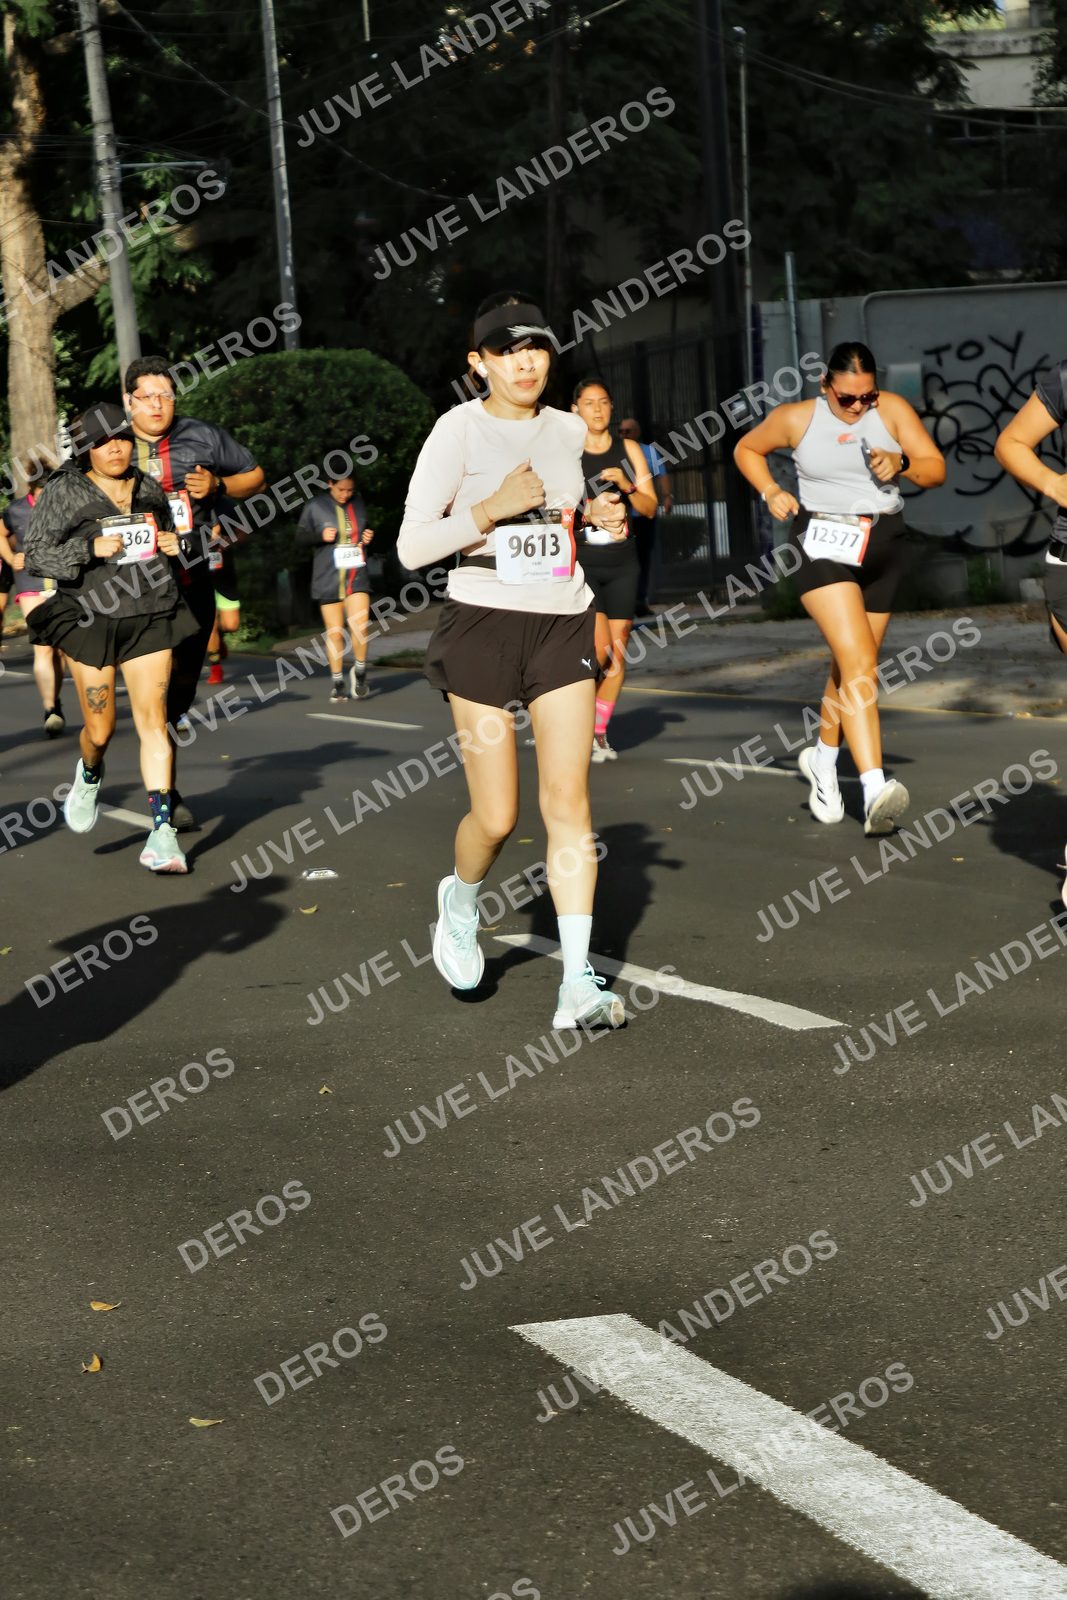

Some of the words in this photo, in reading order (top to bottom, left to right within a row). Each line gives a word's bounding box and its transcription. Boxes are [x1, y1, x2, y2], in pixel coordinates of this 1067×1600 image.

[923, 330, 1024, 370] TOY
[117, 529, 151, 548] 362
[508, 533, 561, 558] 9613
[812, 526, 860, 548] 12577
